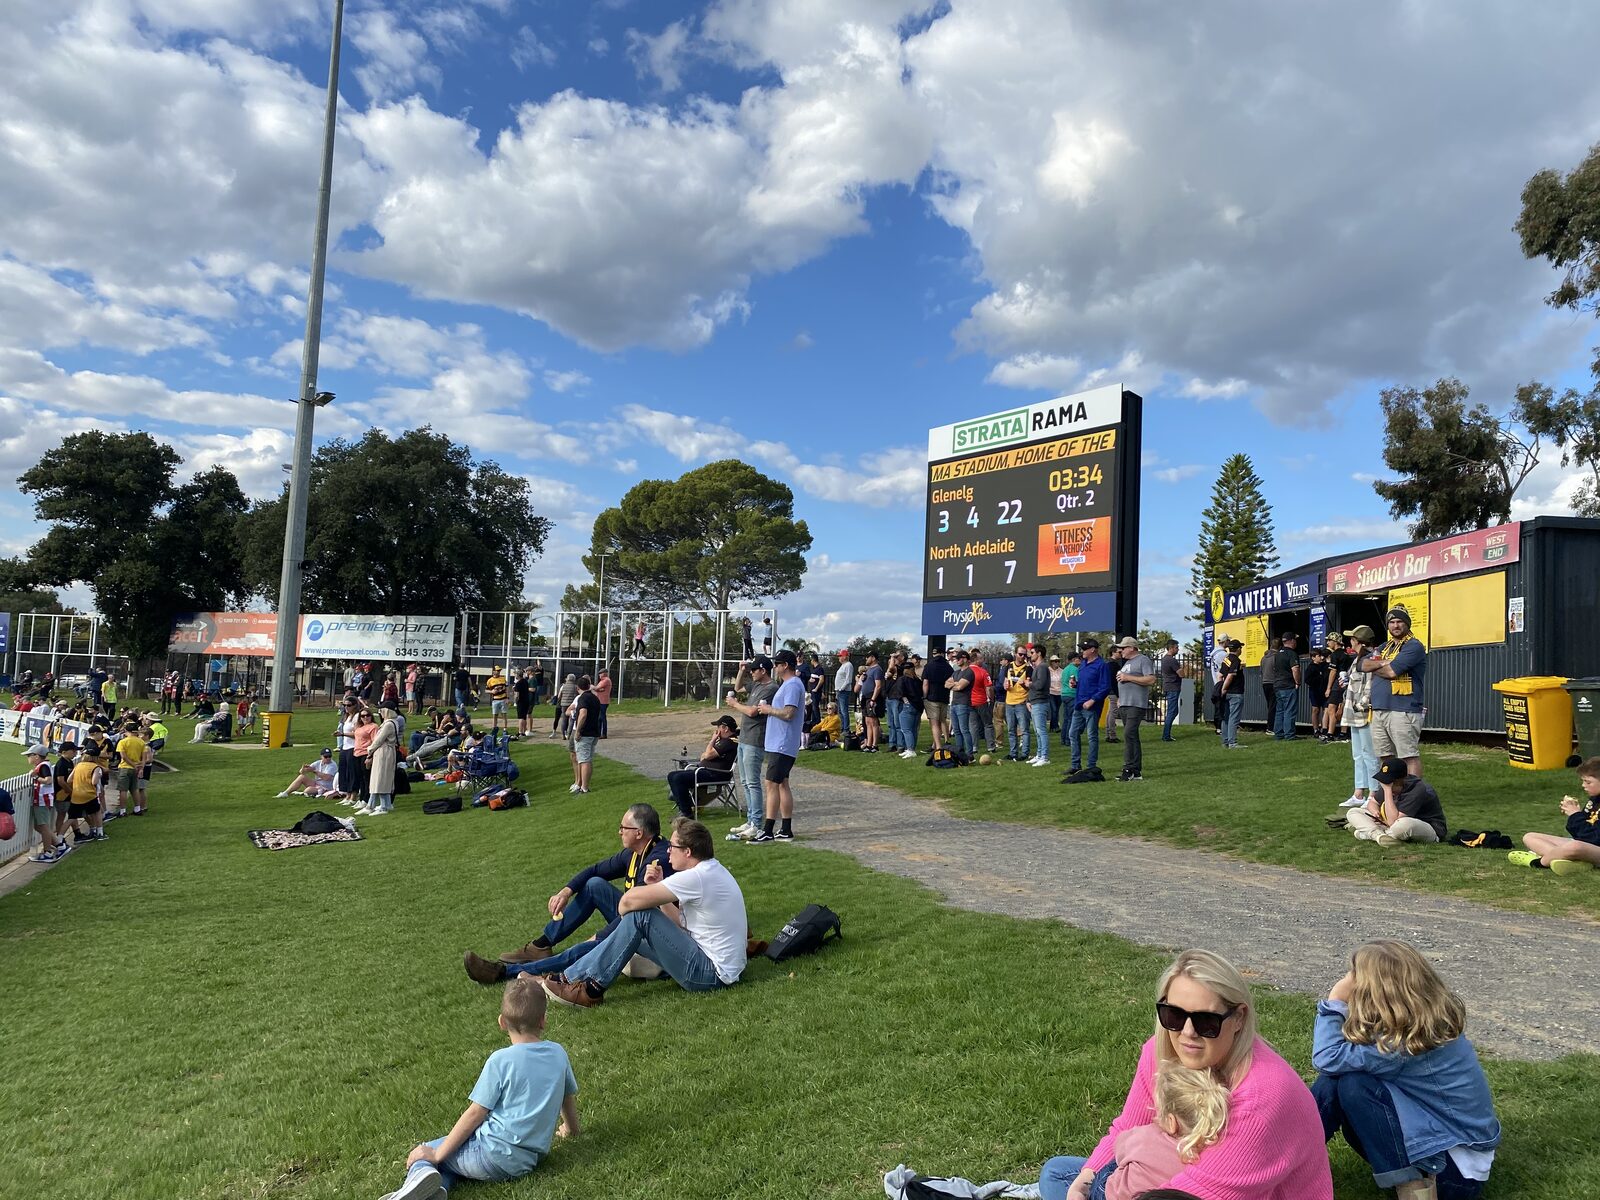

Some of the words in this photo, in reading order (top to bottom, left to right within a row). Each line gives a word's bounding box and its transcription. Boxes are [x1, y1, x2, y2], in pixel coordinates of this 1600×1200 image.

[957, 417, 1024, 447] STRATA
[1032, 401, 1088, 431] RAMA
[953, 456, 1010, 477] STADIUM,
[1014, 444, 1055, 467] HOME
[1058, 439, 1076, 457] OF
[1082, 433, 1111, 452] THE
[1049, 463, 1103, 492] 03:34
[932, 485, 974, 503] Glenelg
[1056, 494, 1082, 513] Qtr.
[1085, 490, 1095, 506] 2
[938, 510, 950, 533] 3
[966, 505, 979, 528] 4
[997, 499, 1023, 525] 22
[1054, 526, 1093, 545] FITNESS
[1486, 534, 1507, 547] WEST
[930, 544, 961, 560] North
[963, 537, 1015, 557] Adelaide
[1054, 541, 1093, 555] WAREHOUSE
[1487, 547, 1504, 559] END
[936, 566, 944, 590] 1
[966, 563, 974, 587] 1
[1004, 560, 1017, 584] 7
[1356, 556, 1400, 588] Snout's
[1404, 553, 1432, 577] Bar
[1229, 584, 1282, 616] CANTEEN
[326, 621, 449, 635] premierpanel
[304, 647, 390, 657] www.premierpanel.com.au
[395, 648, 418, 657] 8345
[422, 648, 445, 658] 3739
